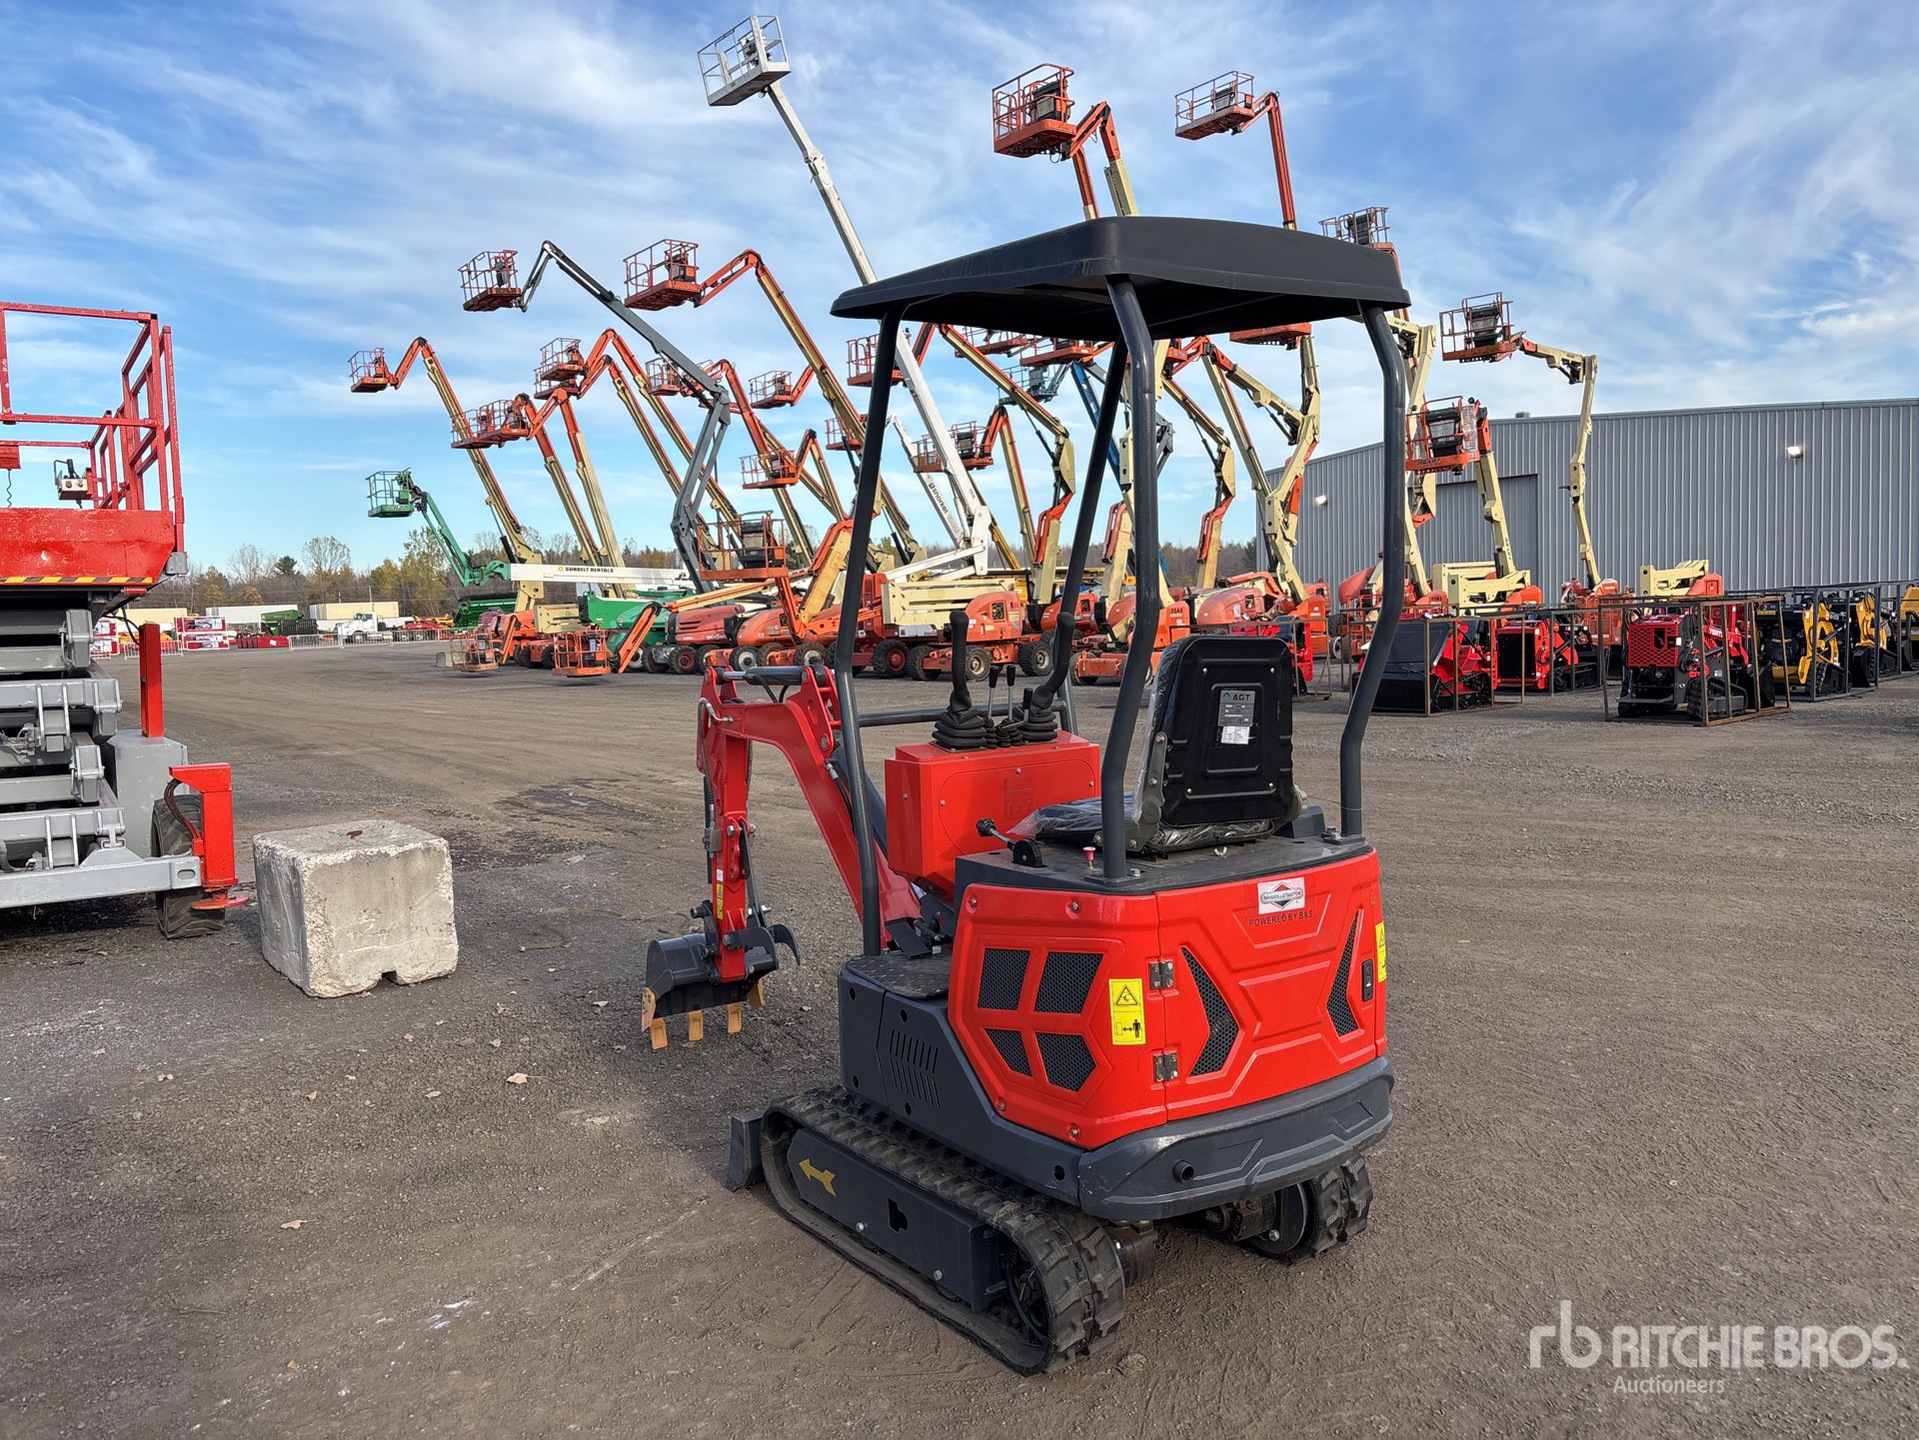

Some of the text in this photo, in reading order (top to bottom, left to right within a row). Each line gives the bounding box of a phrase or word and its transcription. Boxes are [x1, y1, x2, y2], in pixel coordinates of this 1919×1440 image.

[1232, 693, 1251, 701] AGT
[1249, 910, 1313, 927] POWERED BY B&S
